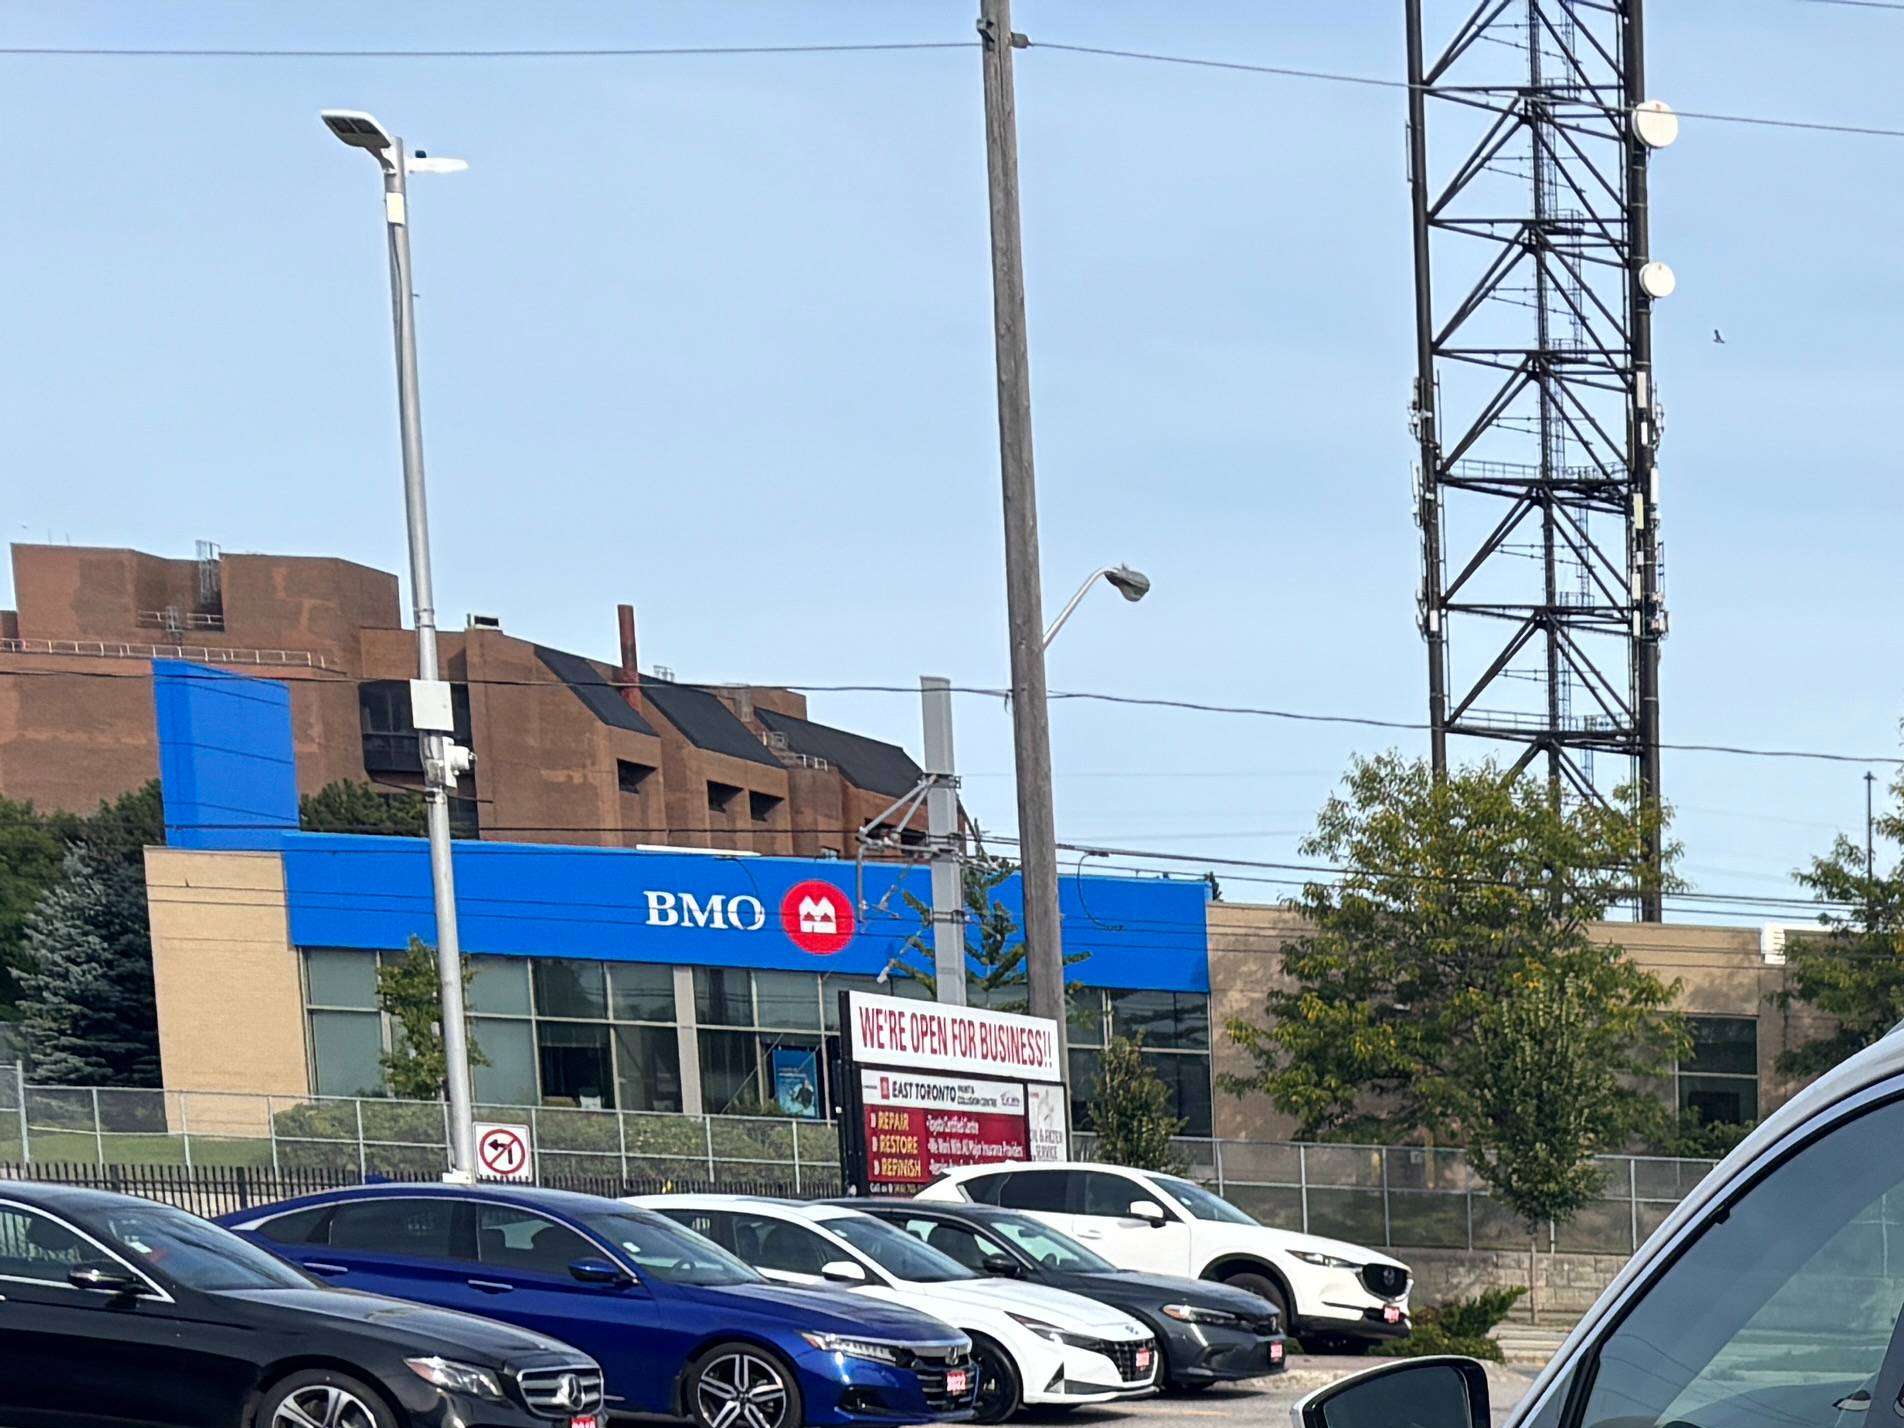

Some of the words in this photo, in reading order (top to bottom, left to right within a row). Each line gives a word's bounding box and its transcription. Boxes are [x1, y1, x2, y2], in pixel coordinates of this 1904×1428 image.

[643, 890, 766, 931] BMO
[859, 1006, 907, 1051] WE'RE
[910, 1012, 948, 1057] OPEN
[952, 1017, 977, 1059] FOR
[979, 1021, 1052, 1068] BUSINESS!!
[892, 1081, 913, 1100] EAST
[914, 1083, 957, 1103] TORONTO
[877, 1111, 909, 1131] REPAIR
[879, 1135, 918, 1154] RESTORE
[881, 1157, 921, 1178] REFINISH
